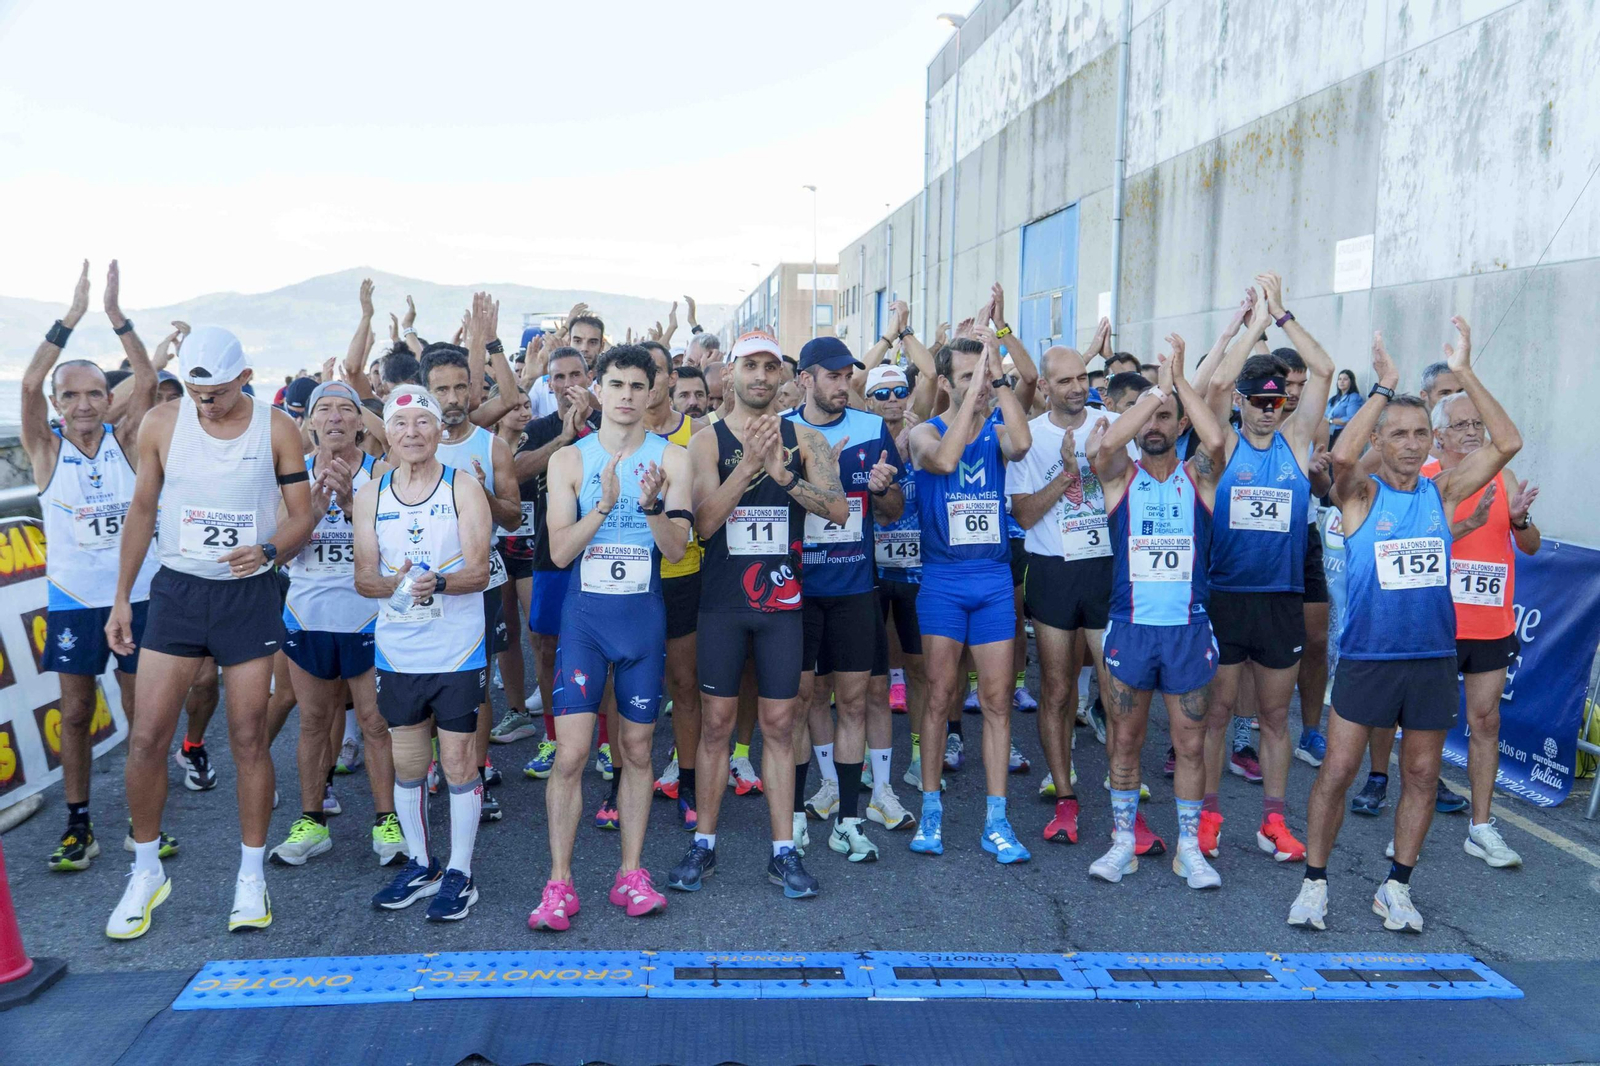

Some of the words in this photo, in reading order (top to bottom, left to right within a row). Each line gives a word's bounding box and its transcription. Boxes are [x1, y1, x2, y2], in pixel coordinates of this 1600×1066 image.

[1252, 489, 1276, 498] ALFONSO
[1276, 491, 1291, 499] MORO
[95, 502, 121, 513] ALFONSO
[747, 509, 773, 517] ALFONSO
[773, 509, 787, 517] MORO
[965, 502, 985, 510] ALFONSO
[1249, 501, 1279, 519] 34
[184, 509, 206, 519] 10KMS
[206, 510, 236, 521] ALFONSO
[236, 513, 254, 522] MORO
[1062, 520, 1079, 528] 10KMS
[1079, 517, 1101, 526] ALFONSO
[88, 515, 125, 537] 15
[965, 514, 989, 532] 66
[203, 525, 239, 547] 23
[321, 531, 347, 539] ALFONSO
[746, 522, 773, 541] 11
[1086, 529, 1101, 546] 3
[1132, 538, 1150, 546] 10KMS
[1150, 538, 1176, 546] ALFONSO
[1176, 538, 1191, 546] MORO
[1378, 543, 1399, 551] 10KMS
[1400, 540, 1427, 550] ALFONSO
[1427, 540, 1443, 548] MORO
[314, 544, 354, 563] 153
[604, 546, 632, 555] ALFONSO
[632, 547, 649, 556] MORO
[883, 542, 919, 558] 143
[1148, 550, 1180, 569] 70
[1392, 553, 1440, 575] 152
[610, 560, 627, 581] 6
[1451, 562, 1470, 570] 10KMS
[1470, 563, 1494, 572] ALFONSO
[1494, 565, 1507, 573] MORO
[1460, 575, 1502, 595] 156
[1515, 748, 1528, 763] en
[1532, 752, 1570, 775] eurobanan
[1530, 763, 1564, 790] Galicia
[705, 955, 807, 963] CRONOTEC
[918, 955, 1018, 963] CRONOTEC
[1126, 956, 1224, 964] CRONOTEC
[428, 969, 634, 982] CRONOTEC
